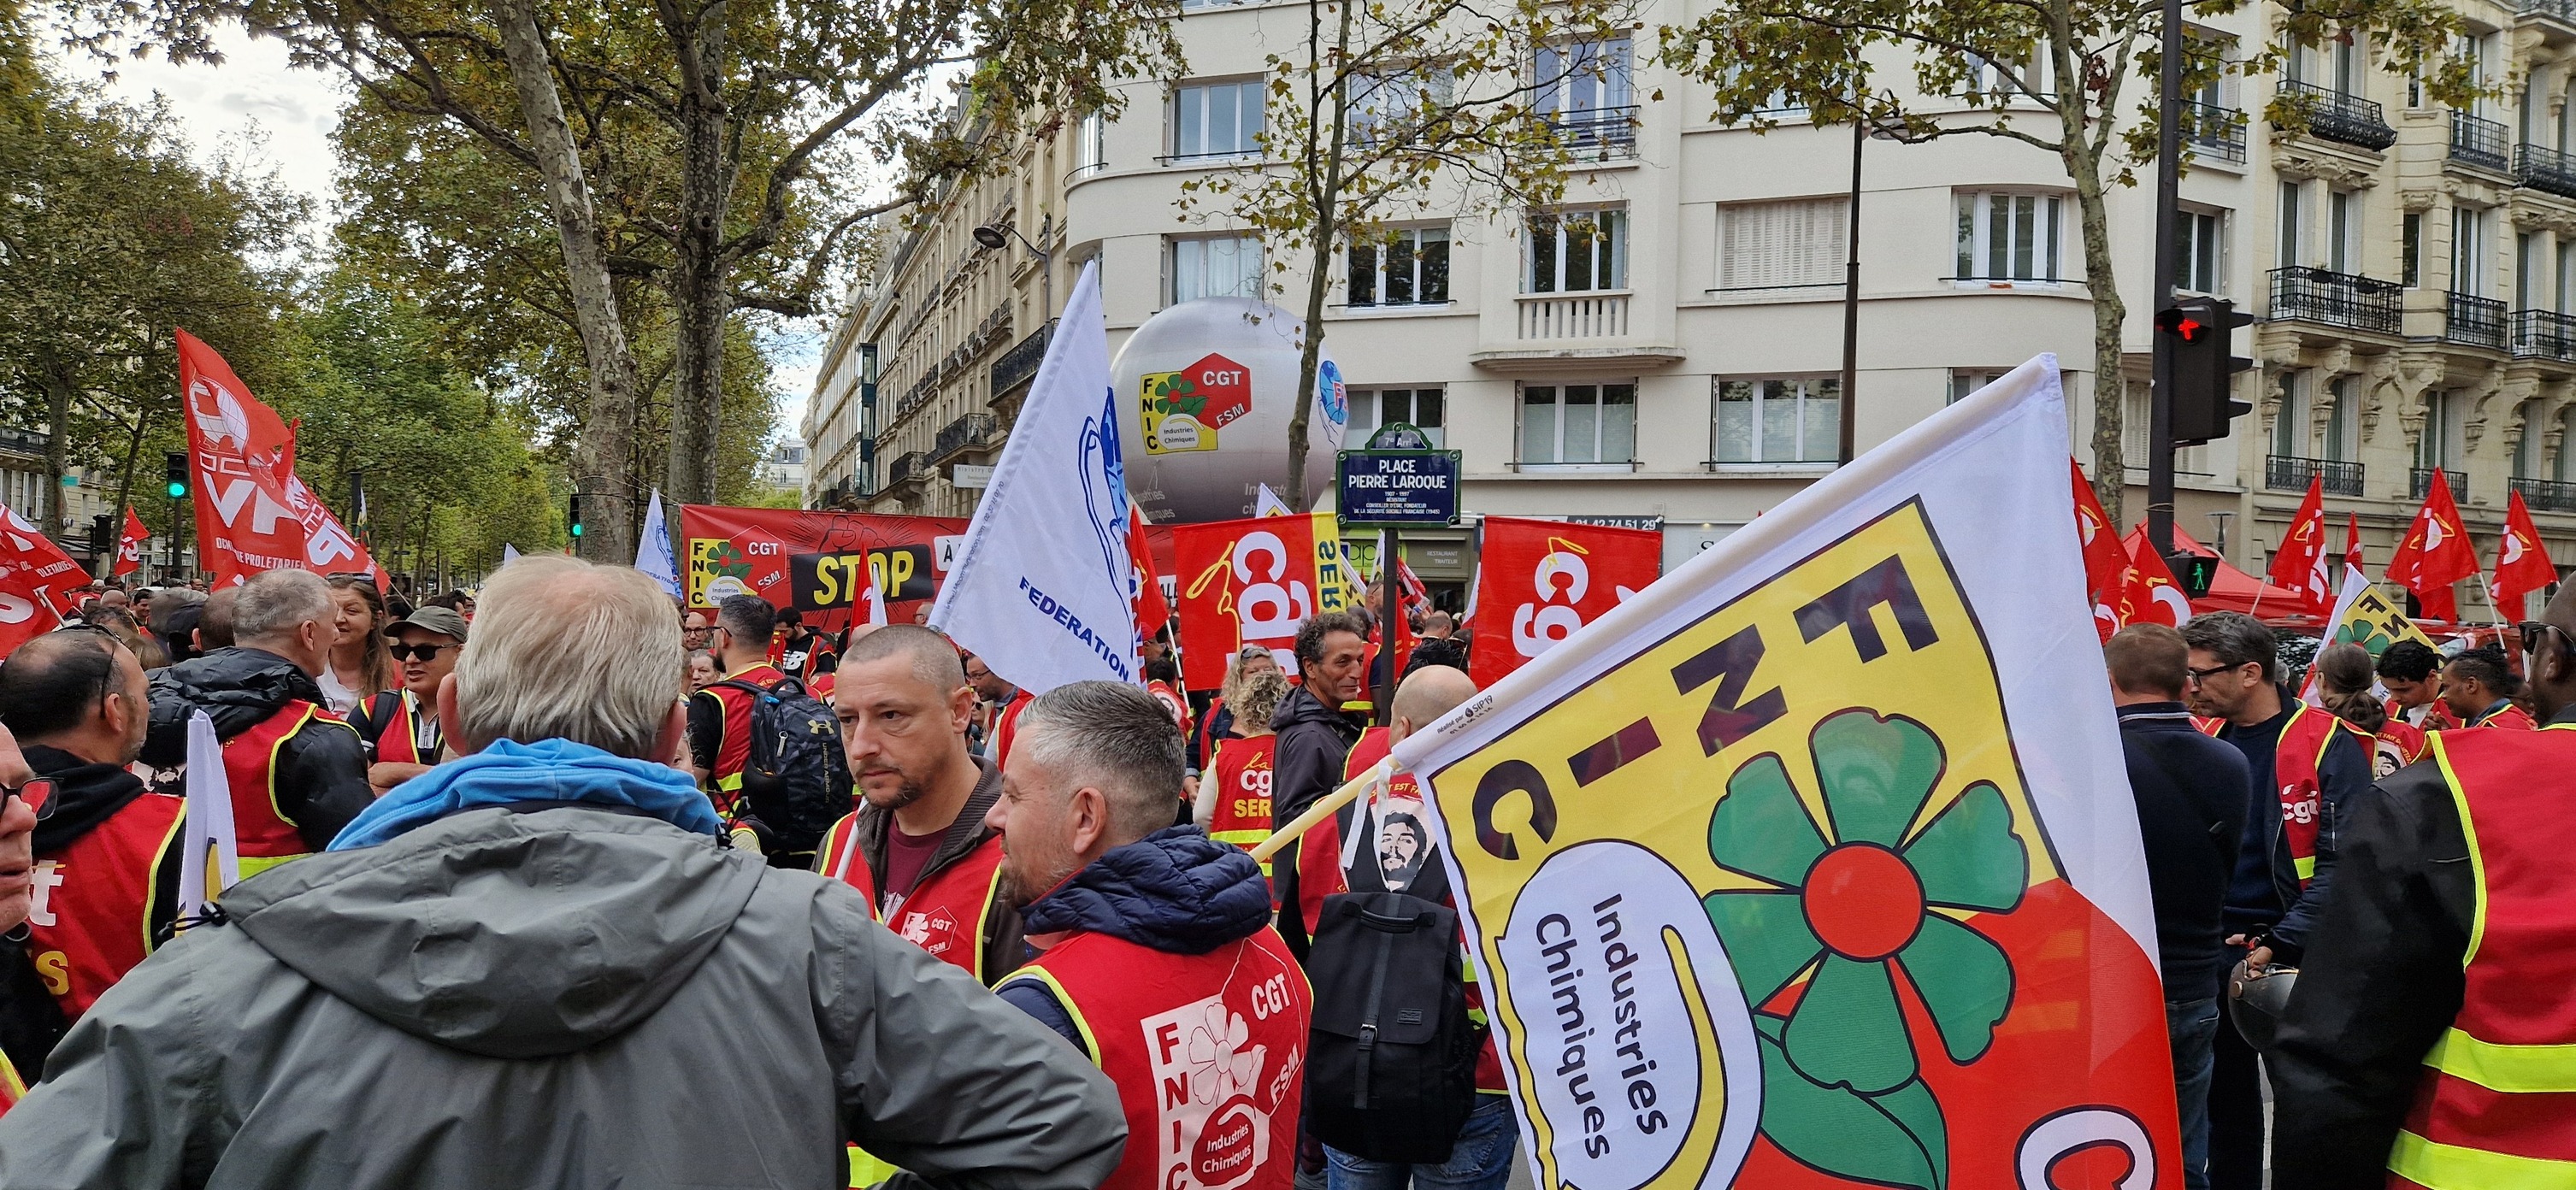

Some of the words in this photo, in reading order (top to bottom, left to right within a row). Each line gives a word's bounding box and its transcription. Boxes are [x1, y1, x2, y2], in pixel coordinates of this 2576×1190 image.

[1202, 370, 1242, 386] CGT
[1216, 403, 1246, 427] FSM
[1164, 435, 1195, 445] Chimiques
[1379, 460, 1416, 473] PLACE
[1348, 475, 1388, 488] PIERRE
[1393, 475, 1447, 490] LAROQUE
[1642, 519, 1656, 530] 29
[748, 542, 779, 556] CGT
[813, 551, 914, 605] STOP
[1019, 574, 1129, 682] FEDERATION
[1436, 720, 1455, 733] Réalisé
[1455, 715, 1464, 724] par
[1472, 695, 1493, 712] SIP19
[1394, 782, 1408, 791] EST
[2282, 799, 2318, 824] cgt
[931, 918, 952, 931] CGT
[928, 942, 946, 955] FSM
[1251, 973, 1291, 1020] CGT
[1593, 892, 1667, 1135] Industries
[1536, 912, 1611, 1159] Chimiques
[1270, 1042, 1300, 1105] FSM
[1206, 1122, 1249, 1153] Industries
[1202, 1144, 1252, 1174] Chimiques
